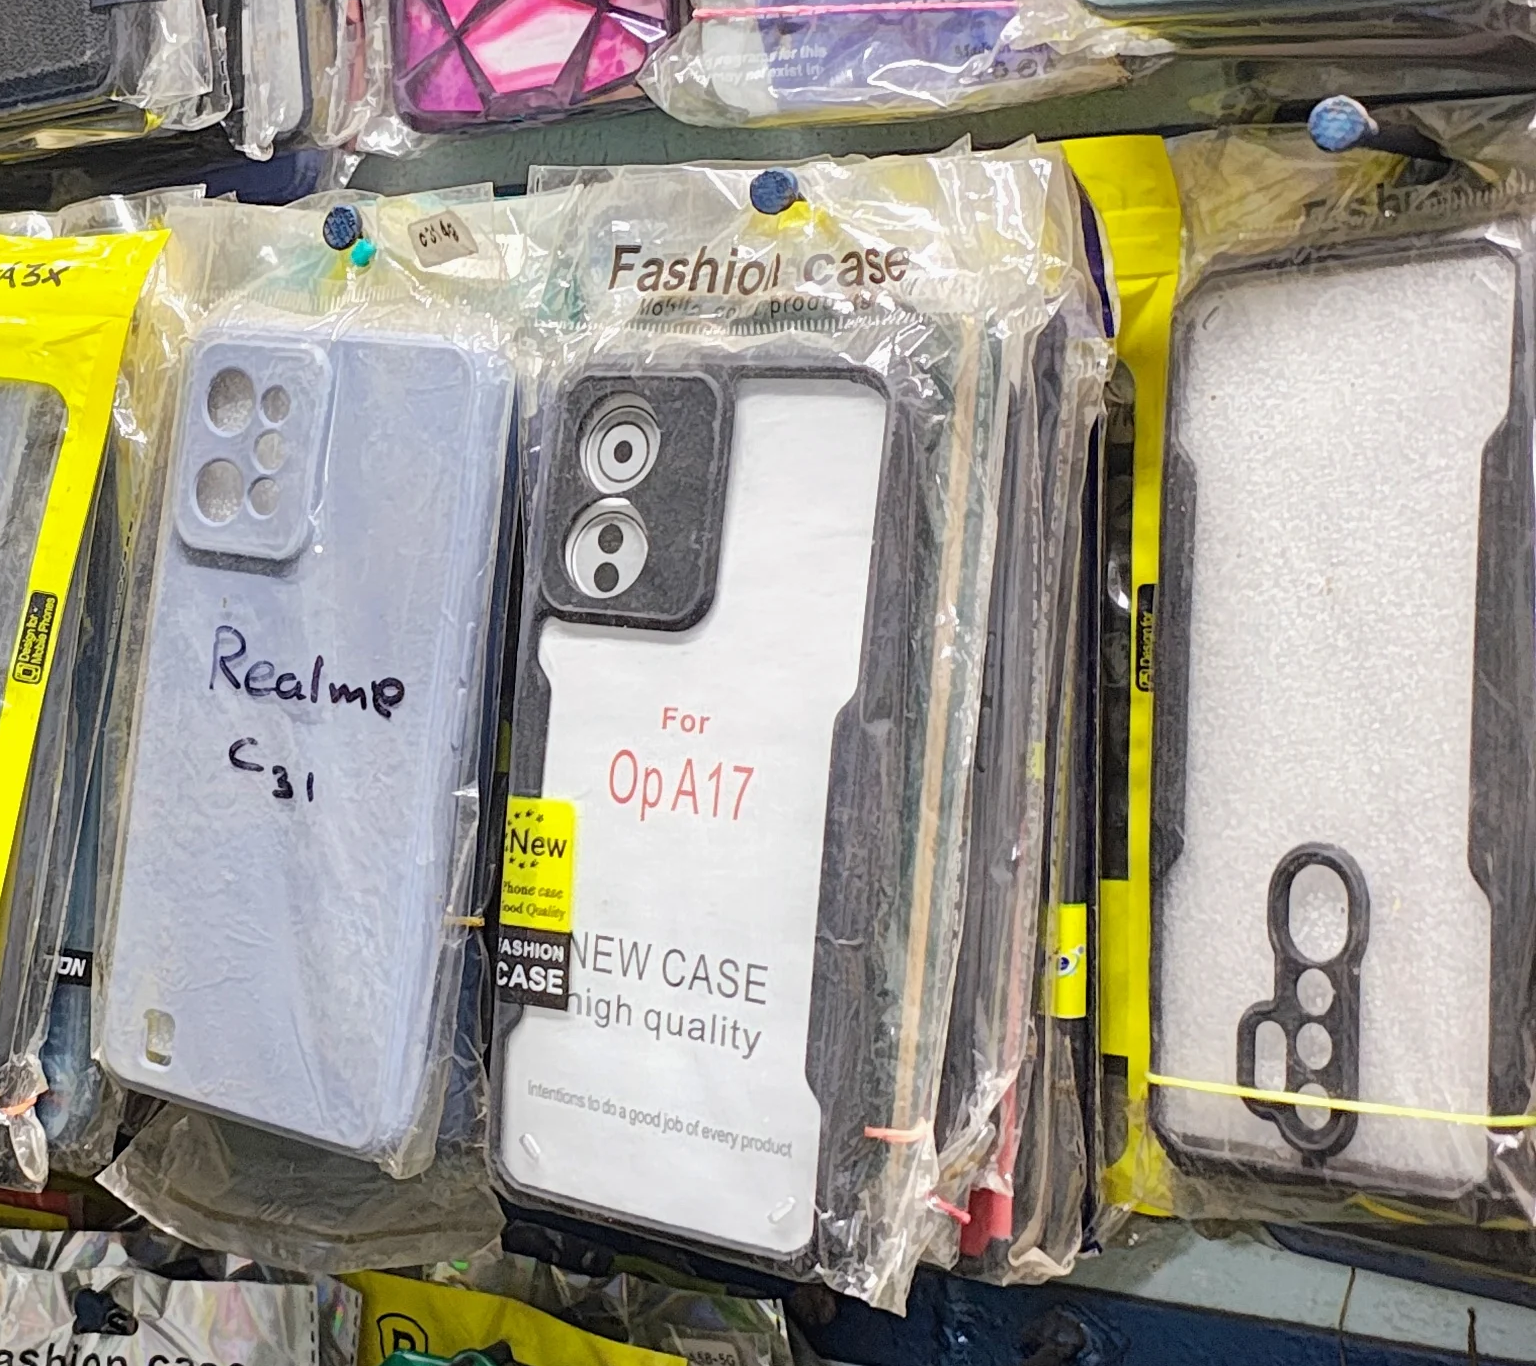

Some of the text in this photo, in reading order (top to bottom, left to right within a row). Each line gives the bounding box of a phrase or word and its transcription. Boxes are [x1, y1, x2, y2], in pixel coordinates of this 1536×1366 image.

[803, 247, 910, 286] case
[18, 629, 37, 661] Design
[30, 597, 55, 664] Mobile Phones
[662, 707, 711, 735] For
[510, 828, 567, 858] New
[538, 885, 563, 899] case
[526, 903, 565, 921] Quality
[496, 961, 563, 995] CASE
[570, 931, 769, 1006] NEW CASE
[643, 1006, 762, 1060] quality
[619, 1107, 626, 1118] a
[629, 1108, 661, 1128] good
[661, 1114, 684, 1133] job
[686, 1120, 699, 1136] of
[701, 1126, 738, 1149] every
[740, 1135, 792, 1158] product
